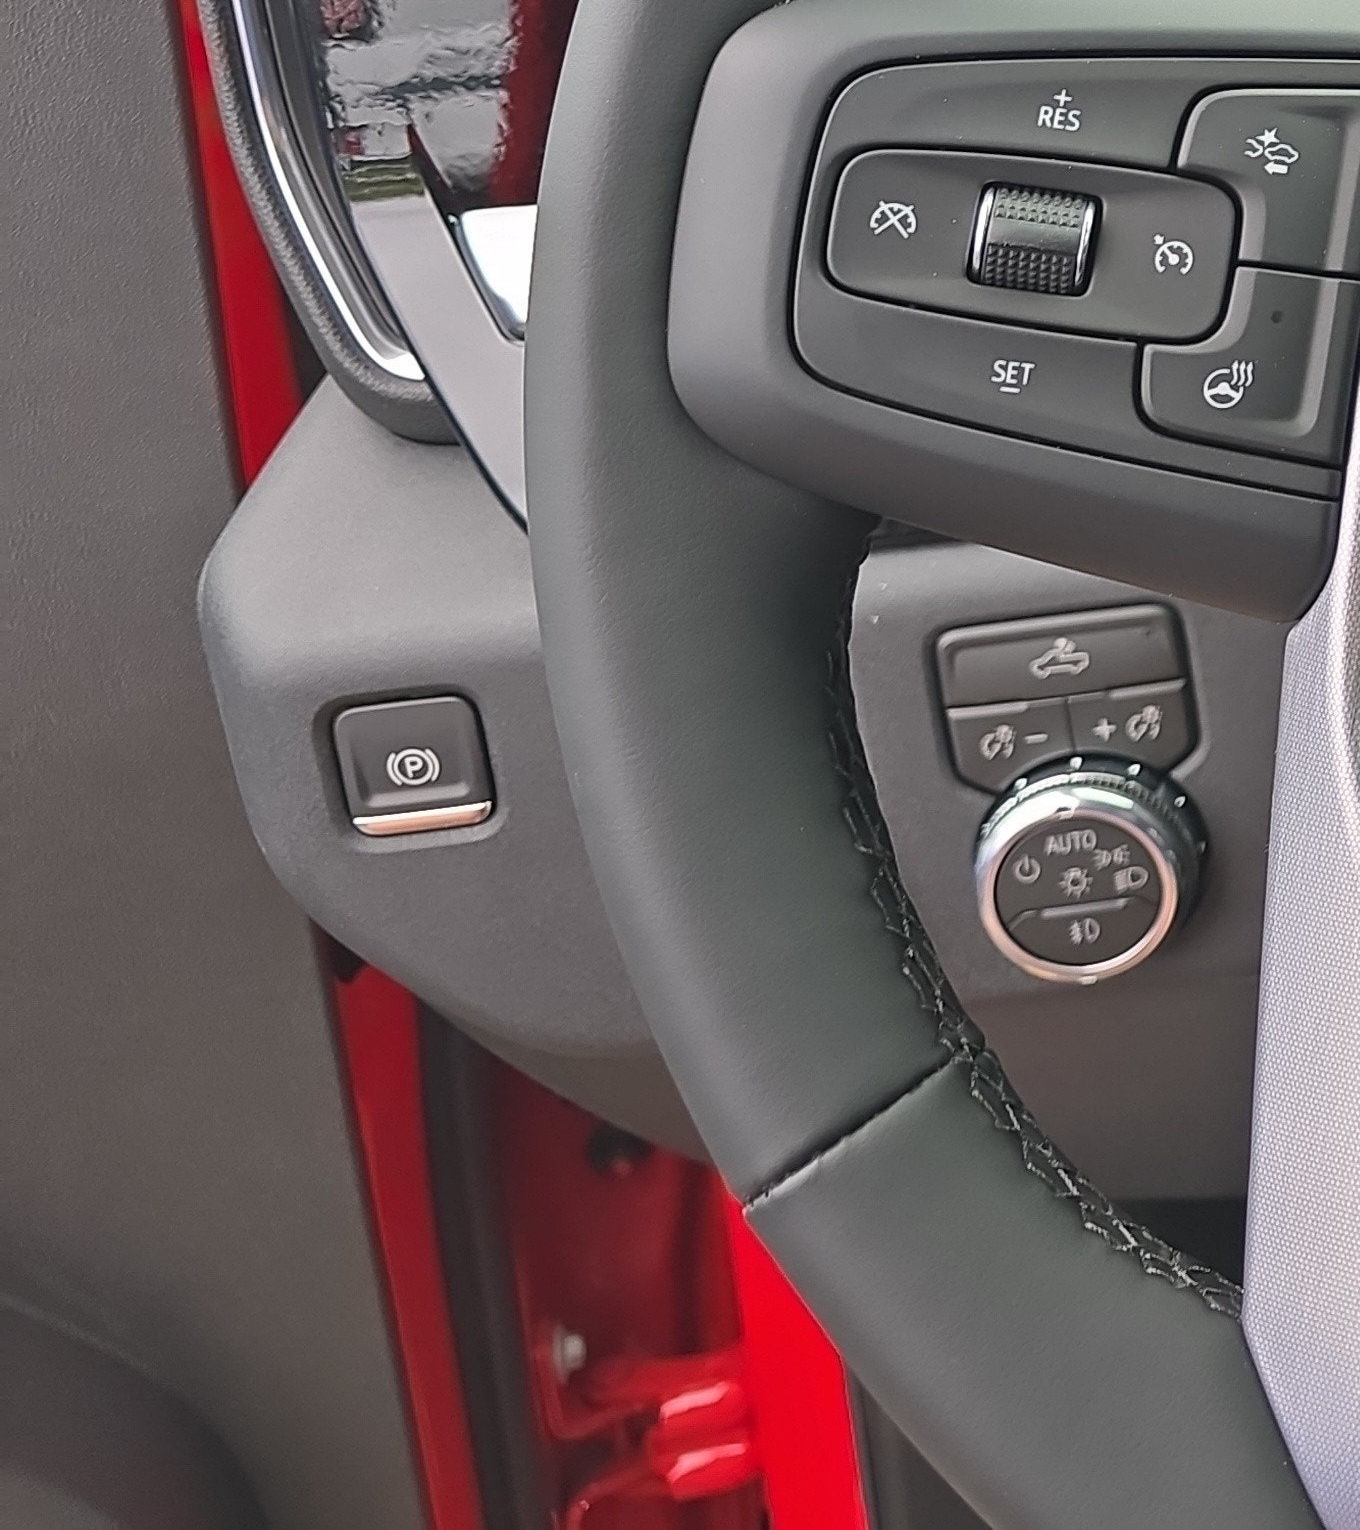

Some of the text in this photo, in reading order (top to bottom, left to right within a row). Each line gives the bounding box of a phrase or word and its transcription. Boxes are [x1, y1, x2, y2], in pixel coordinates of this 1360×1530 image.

[1037, 105, 1081, 132] RES
[990, 359, 1036, 385] SET
[404, 756, 424, 778] P
[1043, 828, 1097, 856] AUTO
